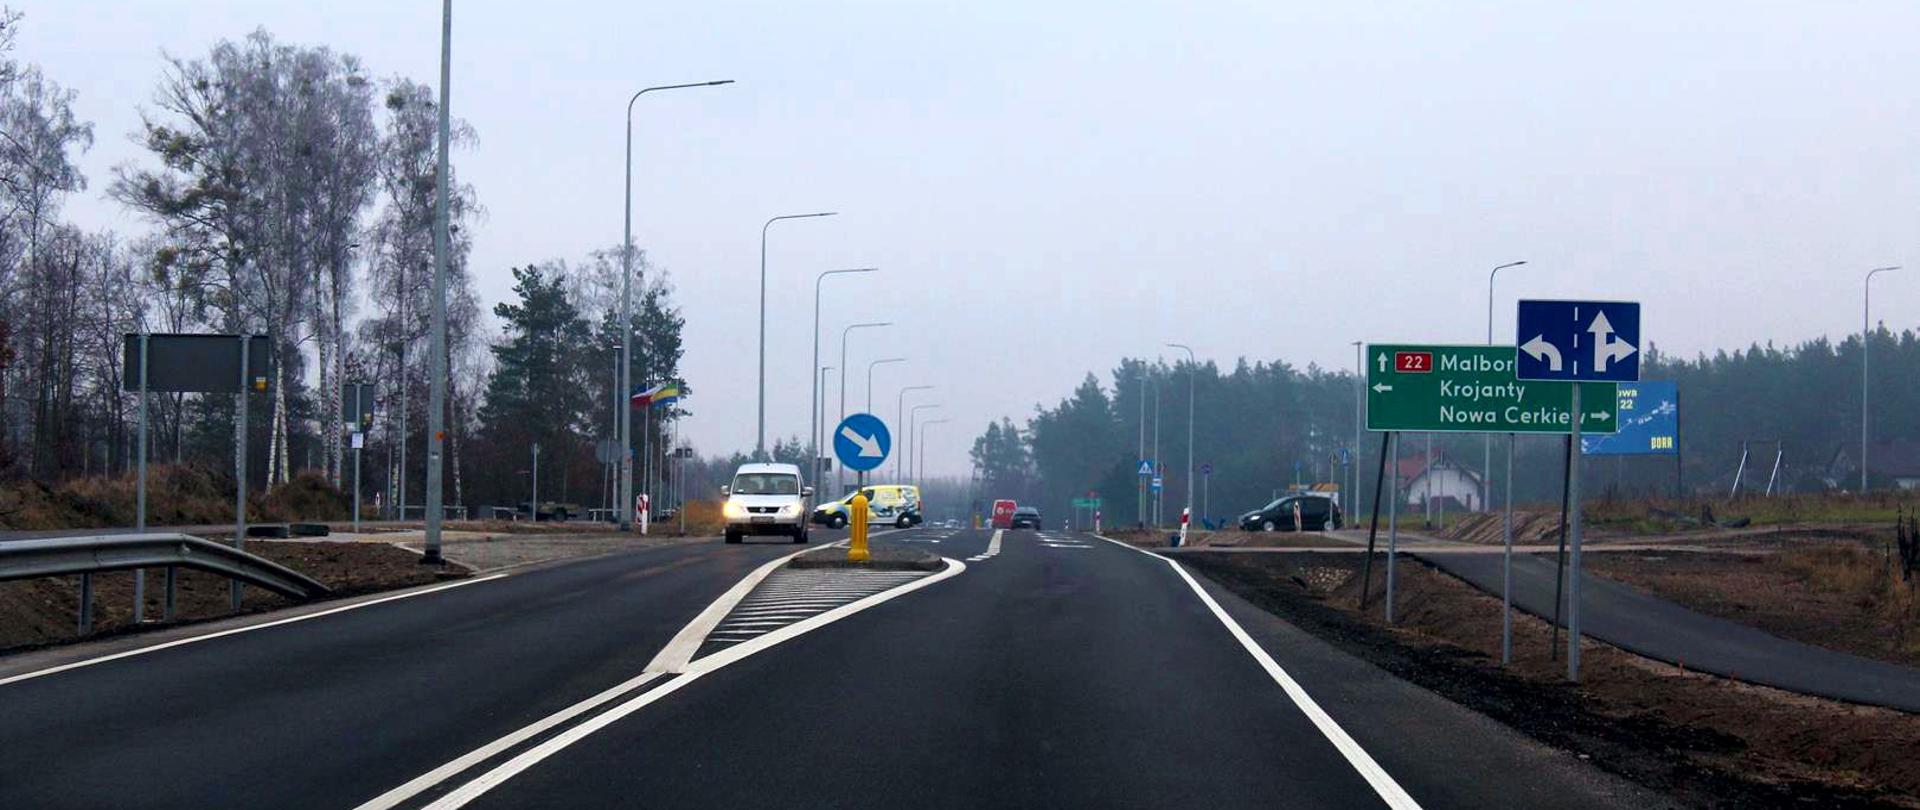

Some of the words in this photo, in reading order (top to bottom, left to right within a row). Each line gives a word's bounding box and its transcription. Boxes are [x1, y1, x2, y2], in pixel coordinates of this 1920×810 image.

[1404, 355, 1424, 369] 22
[1440, 354, 1514, 372] Malbor
[1440, 380, 1525, 402] Krojanty
[1440, 405, 1497, 423] Nowa
